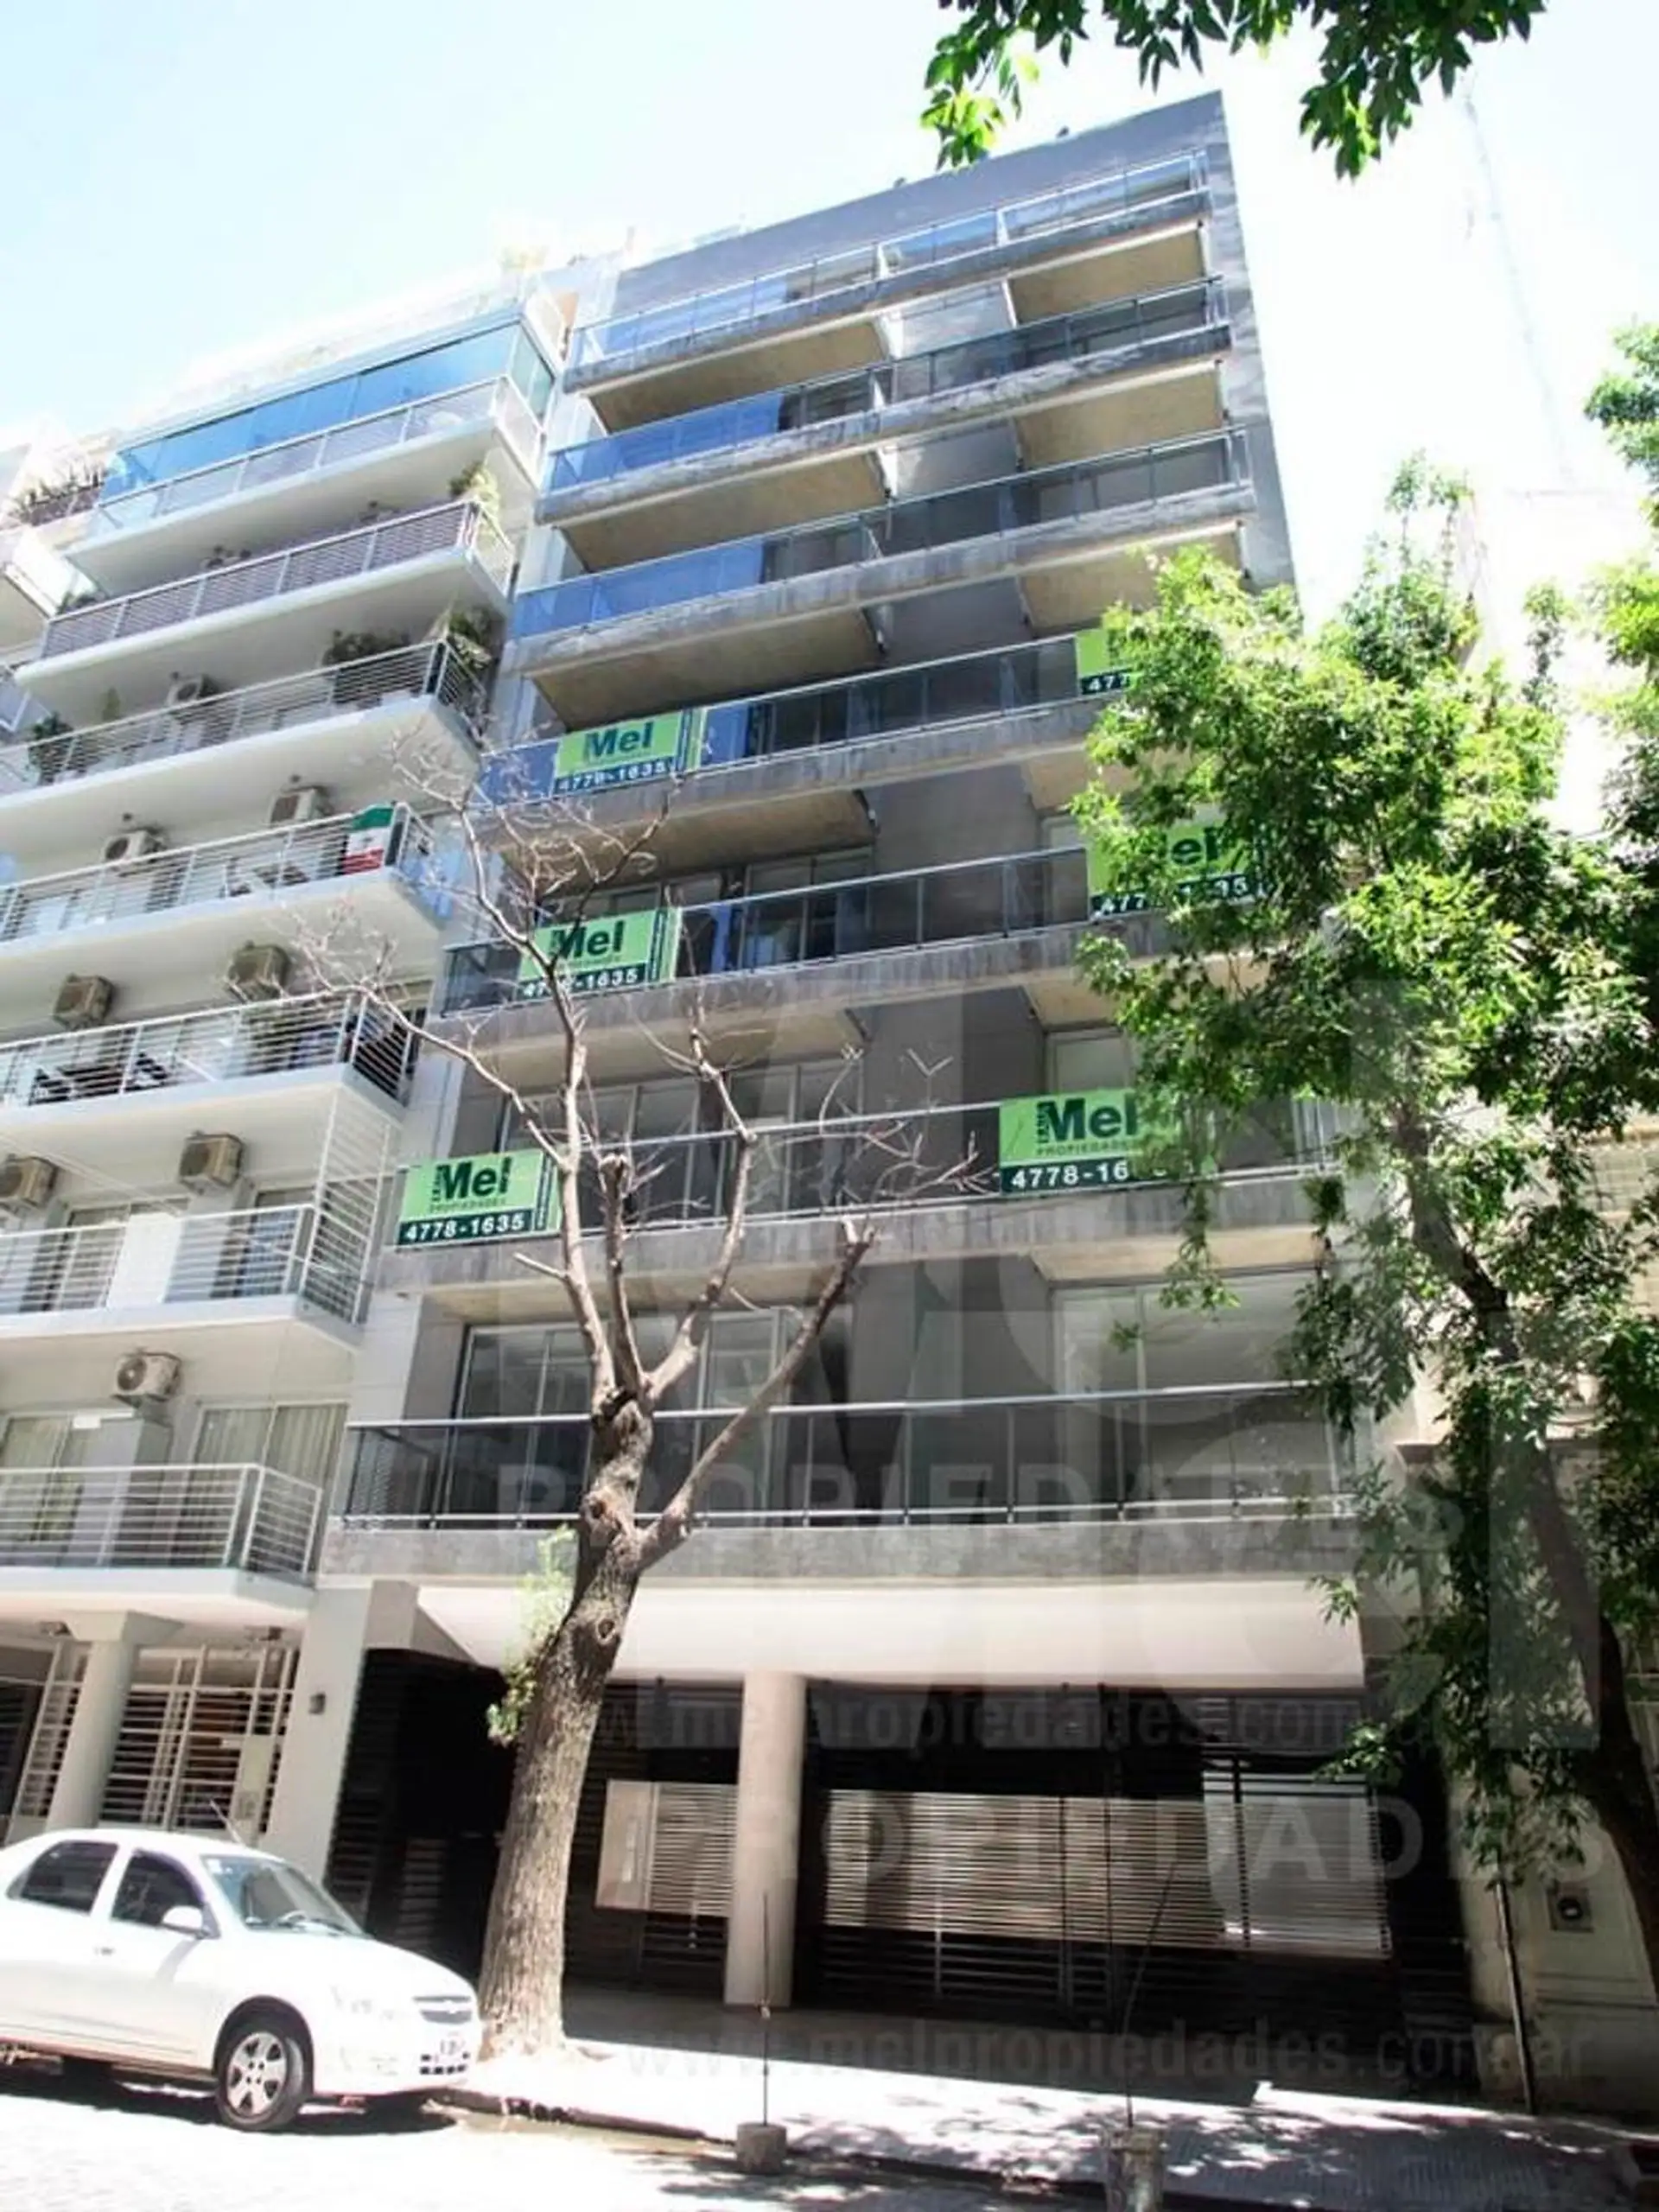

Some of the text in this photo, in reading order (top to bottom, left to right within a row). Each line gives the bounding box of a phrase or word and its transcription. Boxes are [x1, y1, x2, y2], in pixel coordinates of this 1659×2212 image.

[584, 721, 654, 760] Mel
[550, 920, 626, 959] Mel
[524, 968, 639, 997] 478-1635
[1037, 1092, 1139, 1143] Mel
[432, 1156, 512, 1201] Mel
[1011, 1160, 1166, 1189] 4778-16
[404, 1212, 525, 1242] 4778-1635
